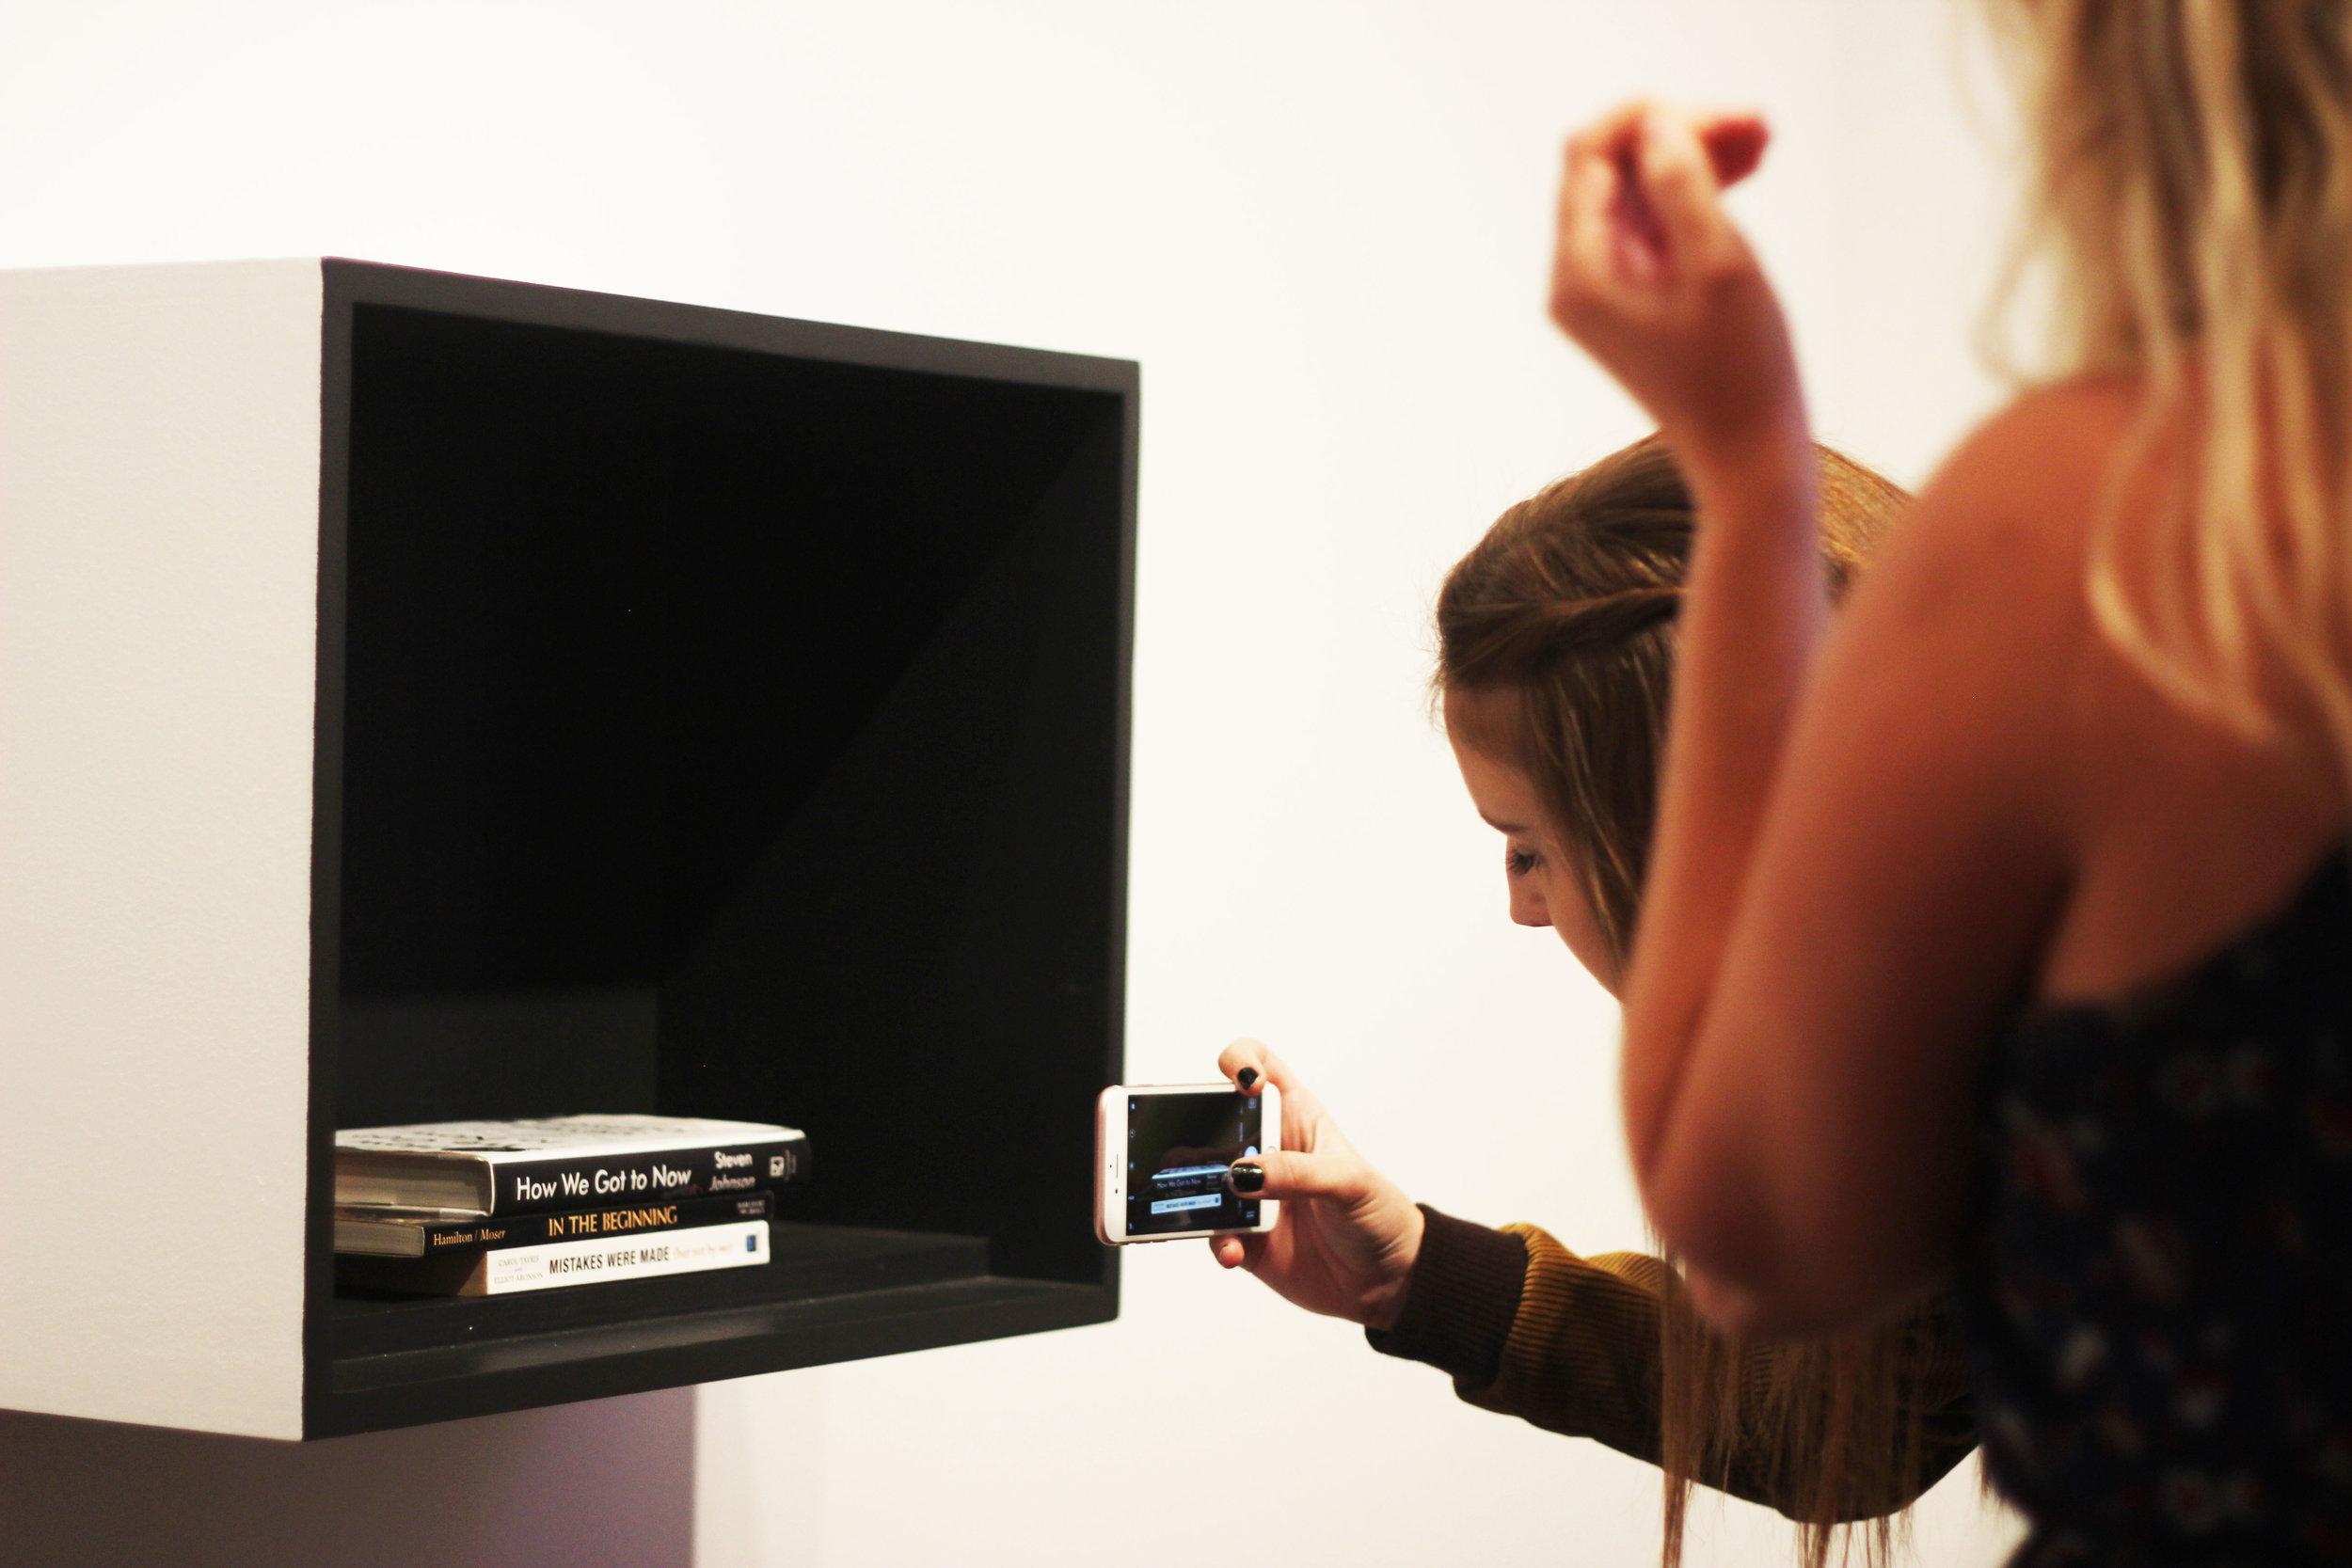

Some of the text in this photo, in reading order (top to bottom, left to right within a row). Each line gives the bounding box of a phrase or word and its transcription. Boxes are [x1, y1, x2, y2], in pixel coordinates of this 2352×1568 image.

[714, 1150, 754, 1169] Steven
[516, 1164, 692, 1201] How We Got to Now
[708, 1173, 755, 1192] Johnson
[548, 1206, 677, 1237] IN THE BEGINNING
[433, 1232, 473, 1246] Hamilton
[480, 1229, 506, 1242] Moser
[549, 1246, 670, 1275] MISTAKES WERE MADE
